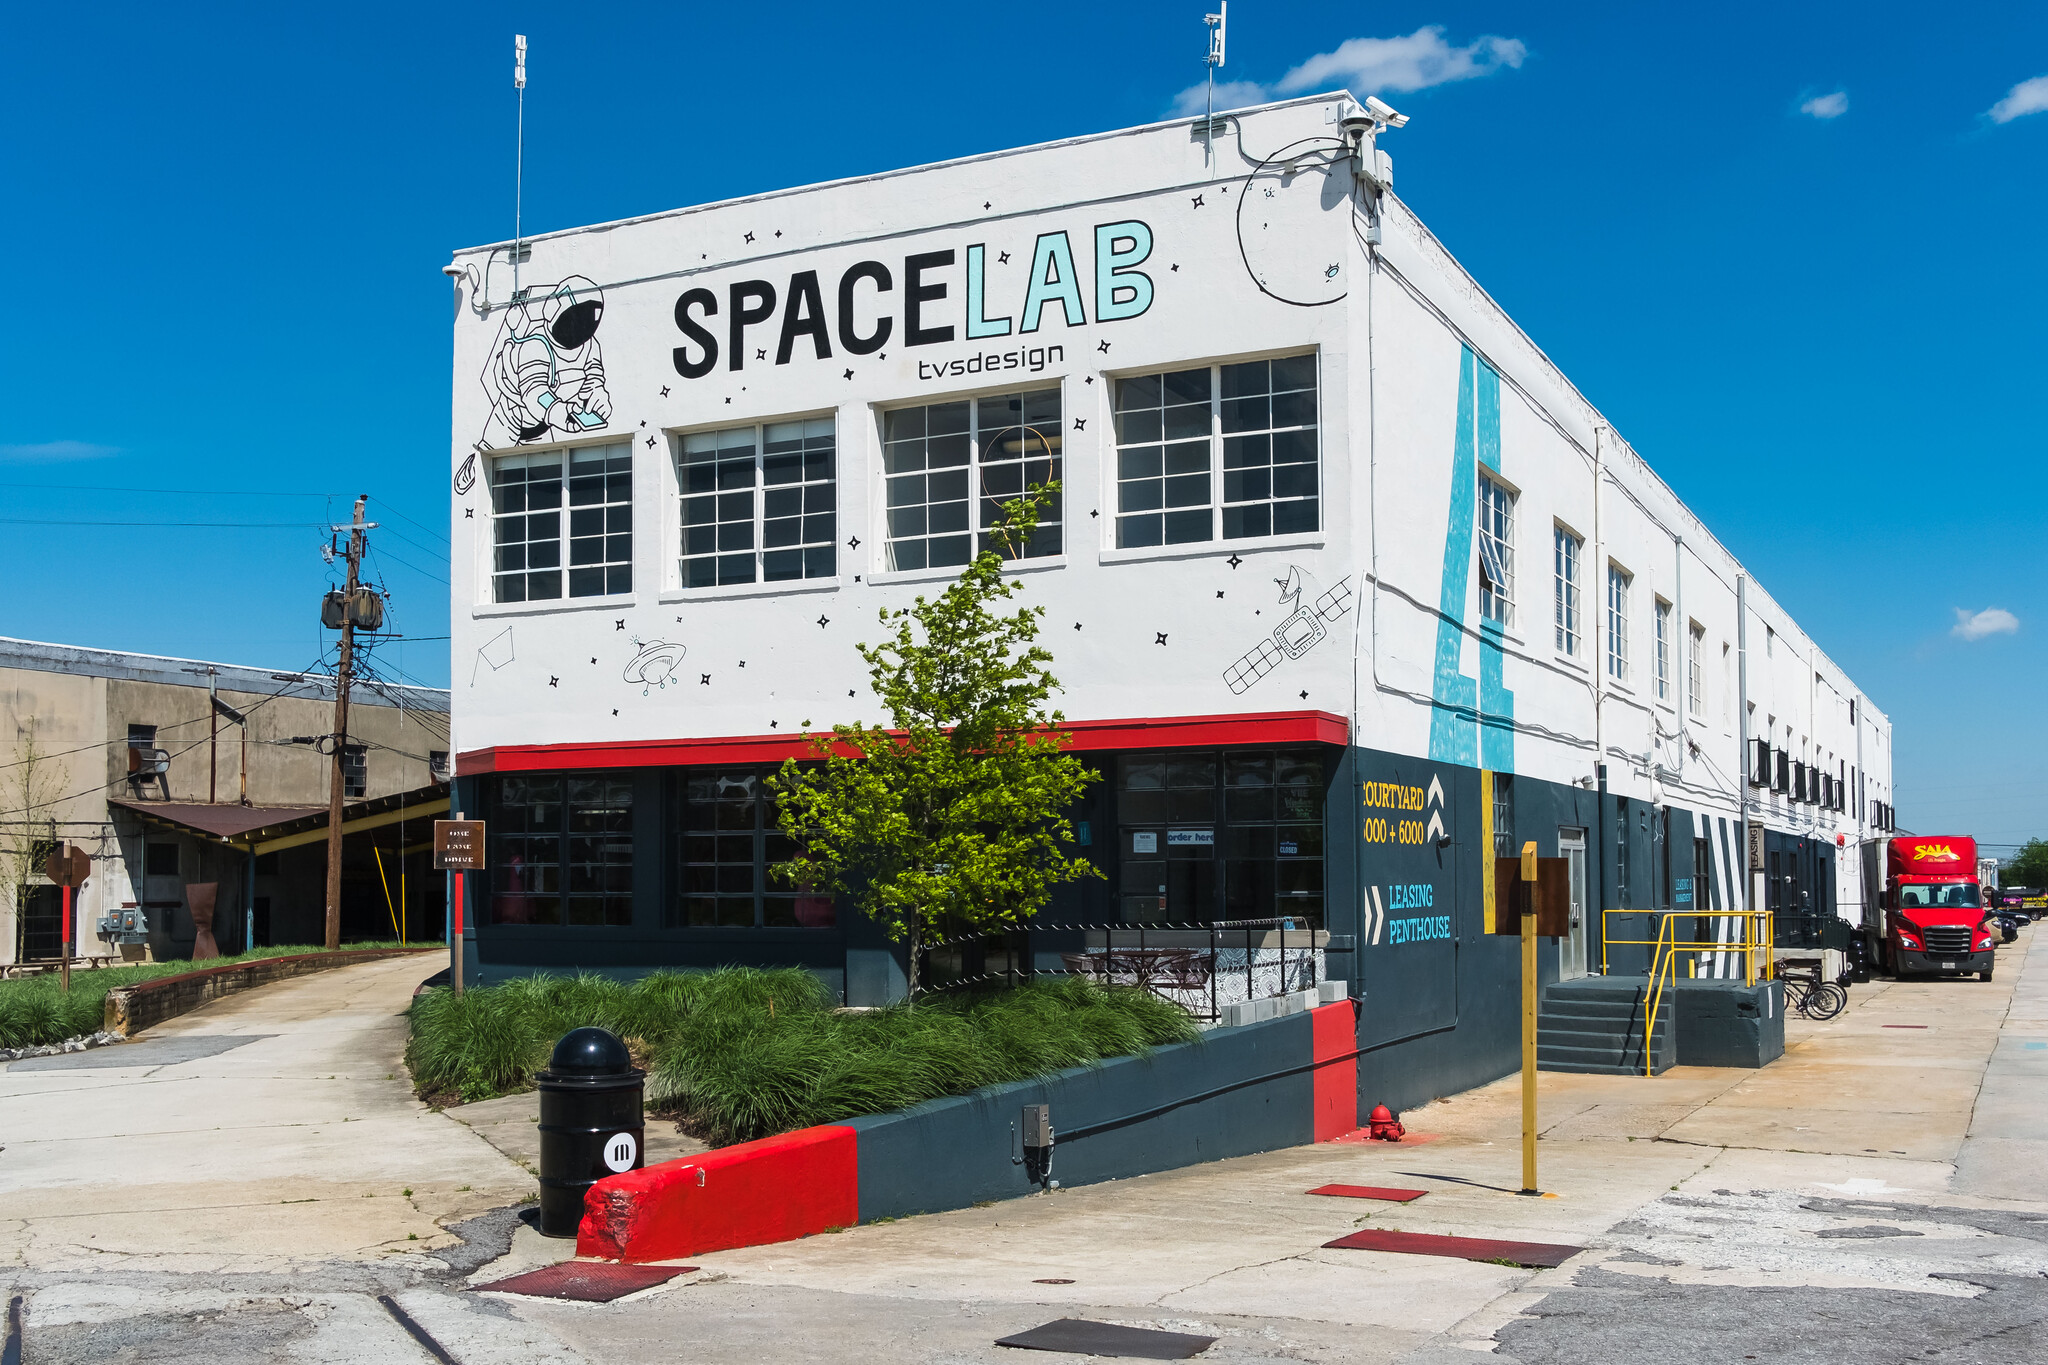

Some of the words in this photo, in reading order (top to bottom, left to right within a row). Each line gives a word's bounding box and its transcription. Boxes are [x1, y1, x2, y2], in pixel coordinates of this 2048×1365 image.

[918, 344, 1064, 380] tvsdesign
[1363, 781, 1424, 811] OURTYARD
[1168, 833, 1192, 841] order
[1363, 817, 1387, 844] 000
[1399, 820, 1424, 845] 6000
[1750, 829, 1758, 868] LEASING
[1913, 845, 1961, 860] SAIA
[1389, 884, 1433, 909] LEASING
[1389, 916, 1450, 945] PENTHOUSE
